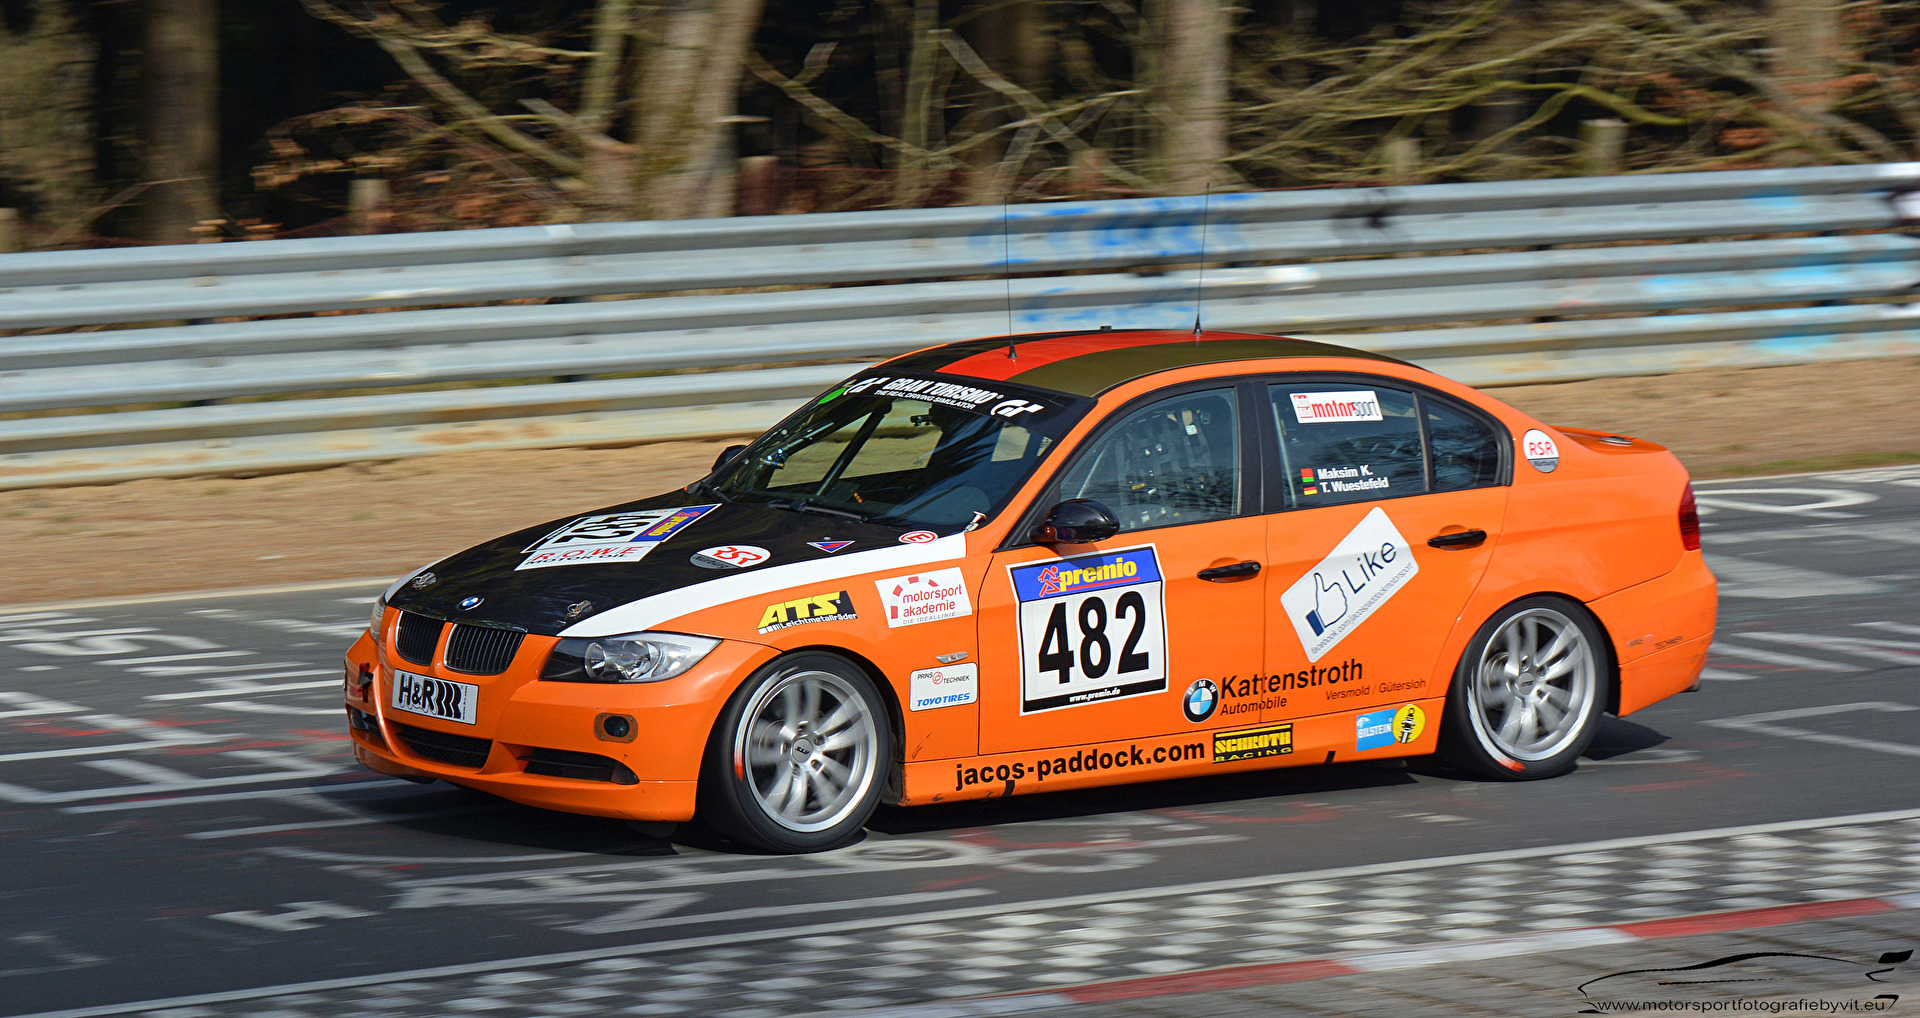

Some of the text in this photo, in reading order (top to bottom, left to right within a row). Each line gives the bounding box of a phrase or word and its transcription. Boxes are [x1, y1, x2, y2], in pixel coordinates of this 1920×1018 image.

[874, 389, 887, 397] THE
[904, 393, 933, 402] DRIVING
[932, 396, 976, 410] SIMULATOR
[881, 377, 998, 405] GRAN TURISMO
[1311, 399, 1380, 419] motorsport
[1529, 441, 1554, 456] RSR
[1317, 464, 1373, 480] Maksim K.
[1319, 477, 1390, 493] T. Wuestefeld
[552, 515, 661, 544] 482
[1059, 557, 1137, 591] premio
[1342, 542, 1396, 594] Like
[902, 584, 963, 604] motorsport
[757, 591, 840, 629] ATS
[903, 600, 956, 618] akademie
[916, 611, 956, 623] IDEALLINIE
[781, 613, 858, 630] Leichtmetallräder
[1038, 591, 1149, 684] 482
[917, 672, 970, 684] PRINS TECHNIEK
[1221, 658, 1363, 699] Kattenstroth
[917, 692, 970, 707] TOYO TIRES
[1069, 687, 1121, 702] www.premio.de
[1325, 684, 1370, 701] Versmold
[1379, 678, 1427, 693] Gütersloh
[1220, 697, 1287, 716] Automobile
[1358, 723, 1392, 738] BILSTEIN
[1214, 731, 1291, 754] SCHROTH
[1214, 746, 1292, 762] RACING
[955, 742, 1205, 791] jacos-paddock.com
